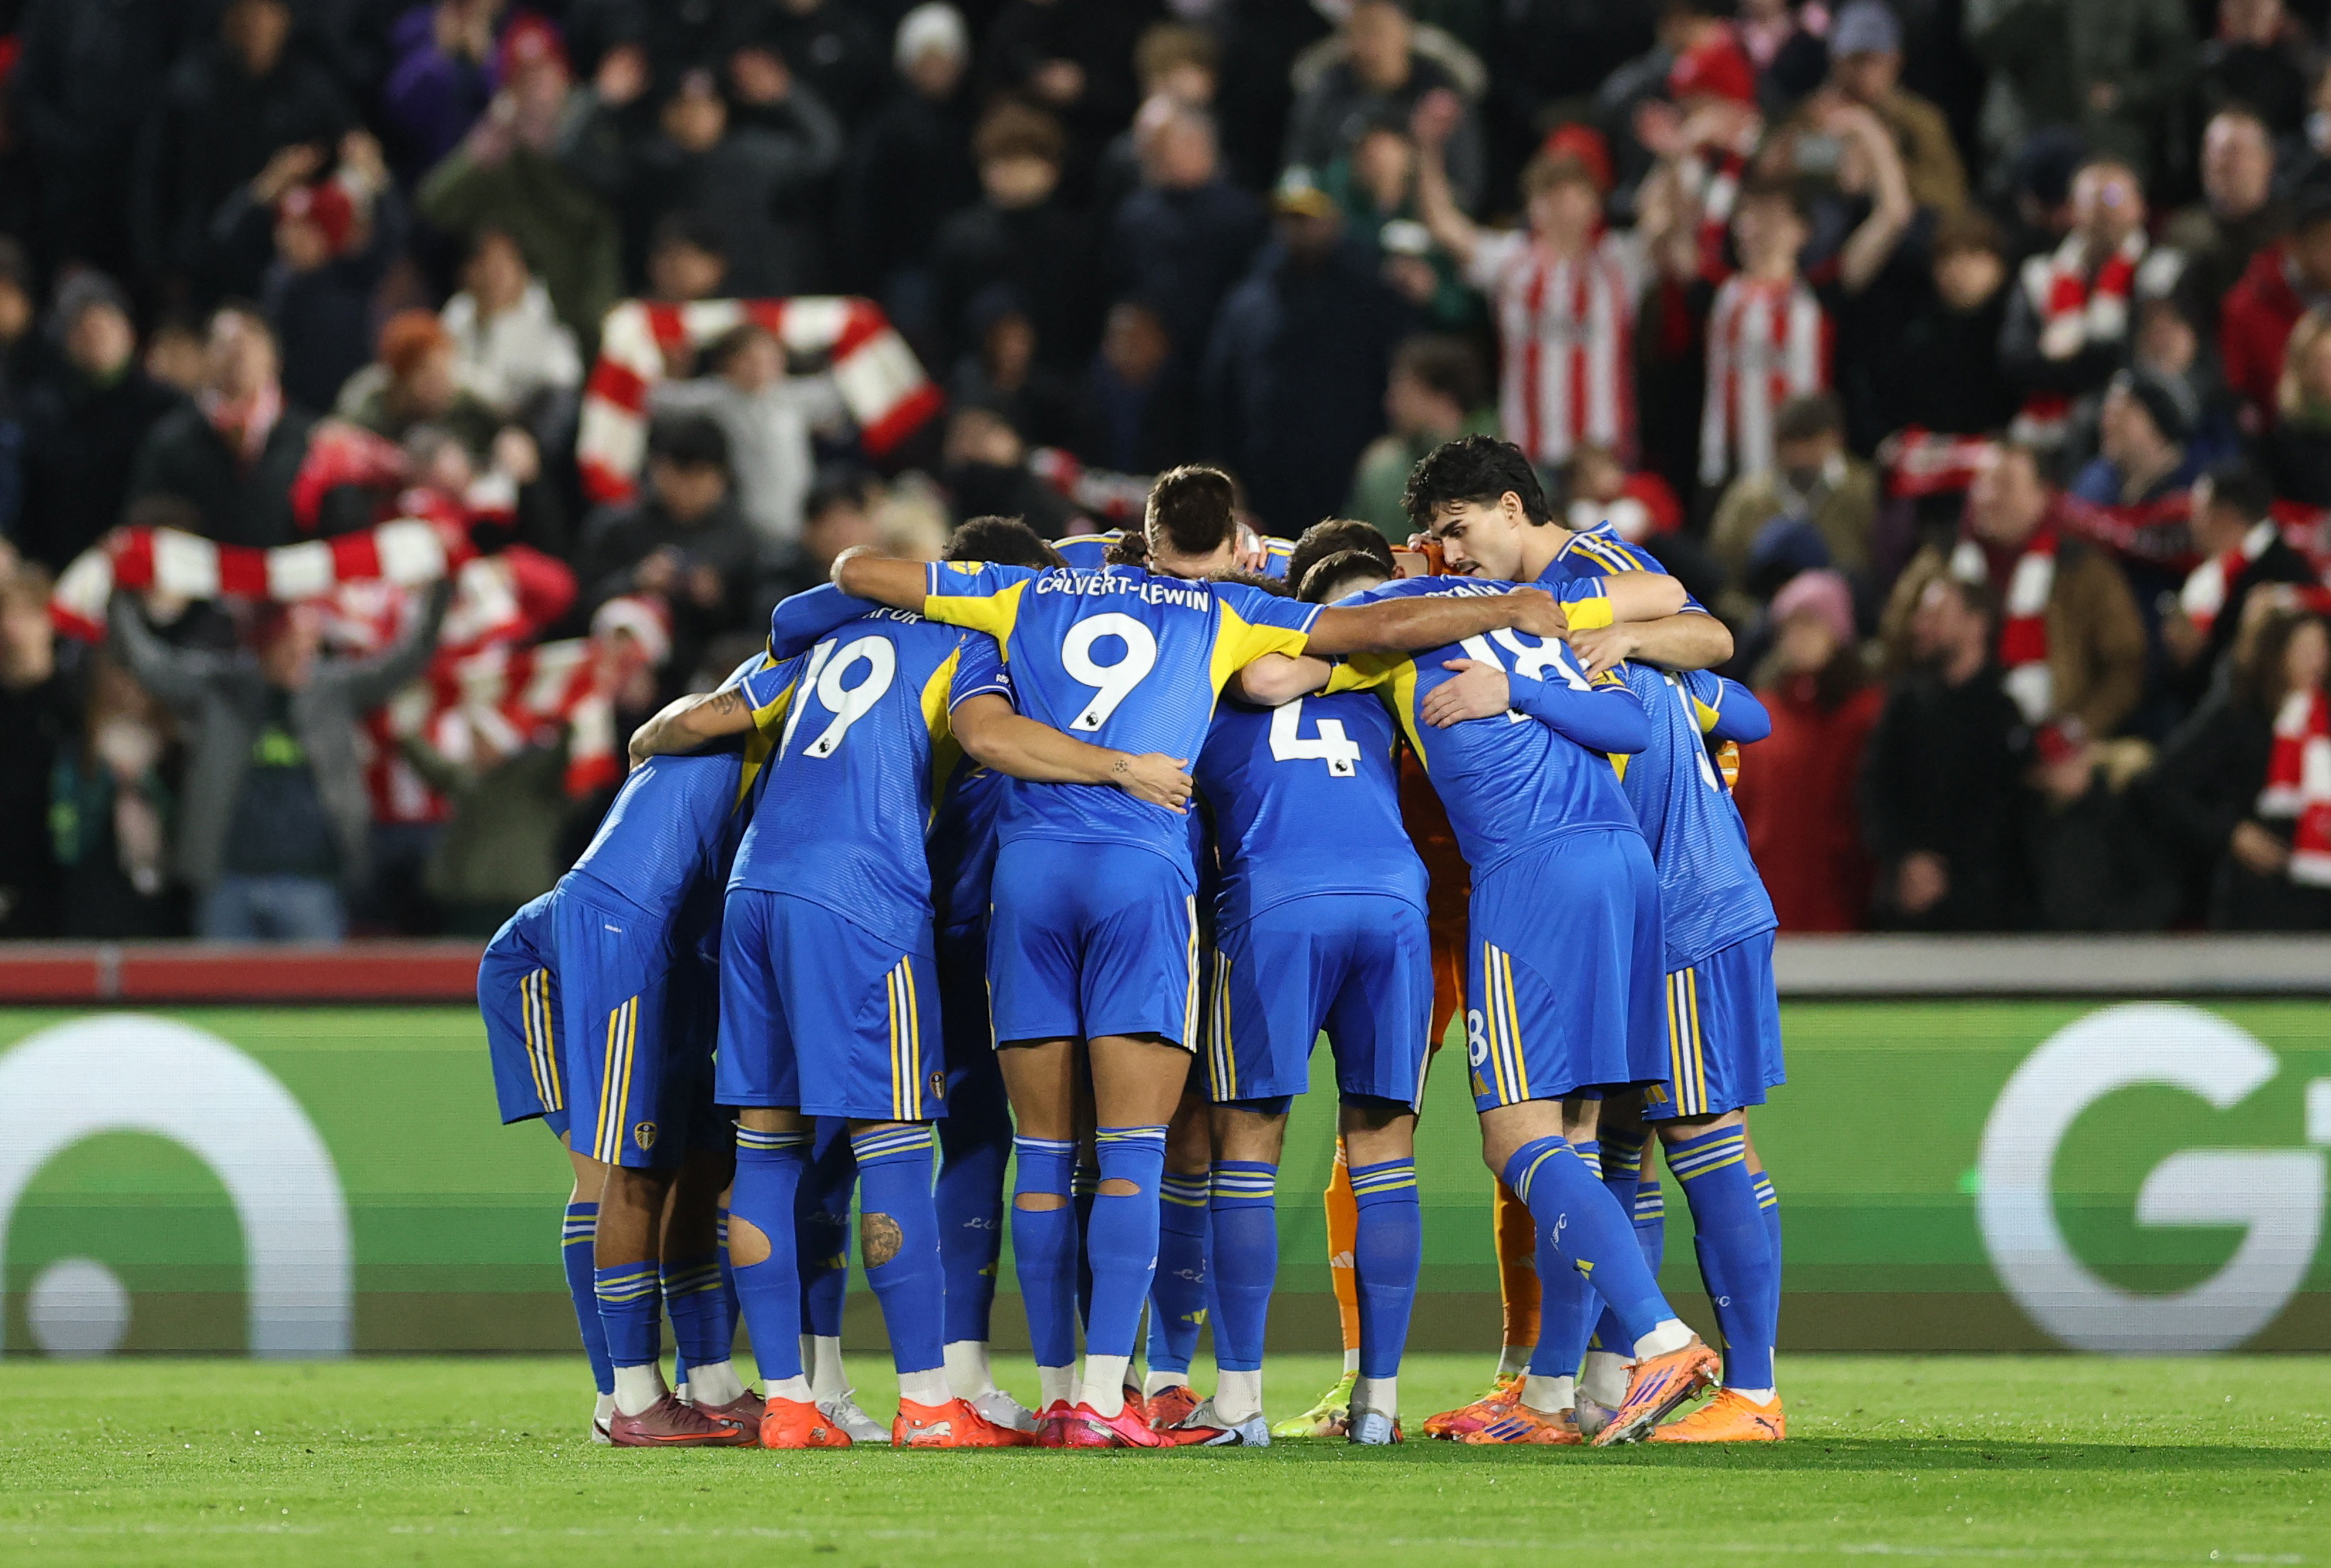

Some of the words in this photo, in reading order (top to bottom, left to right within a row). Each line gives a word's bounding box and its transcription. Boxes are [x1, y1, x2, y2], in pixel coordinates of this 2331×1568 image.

[1036, 575, 1209, 613] CALVERT-LEWIN
[779, 635, 896, 761] 19
[1061, 612, 1157, 731] 9
[1268, 697, 1361, 778] 4
[1467, 1009, 1489, 1067] 8
